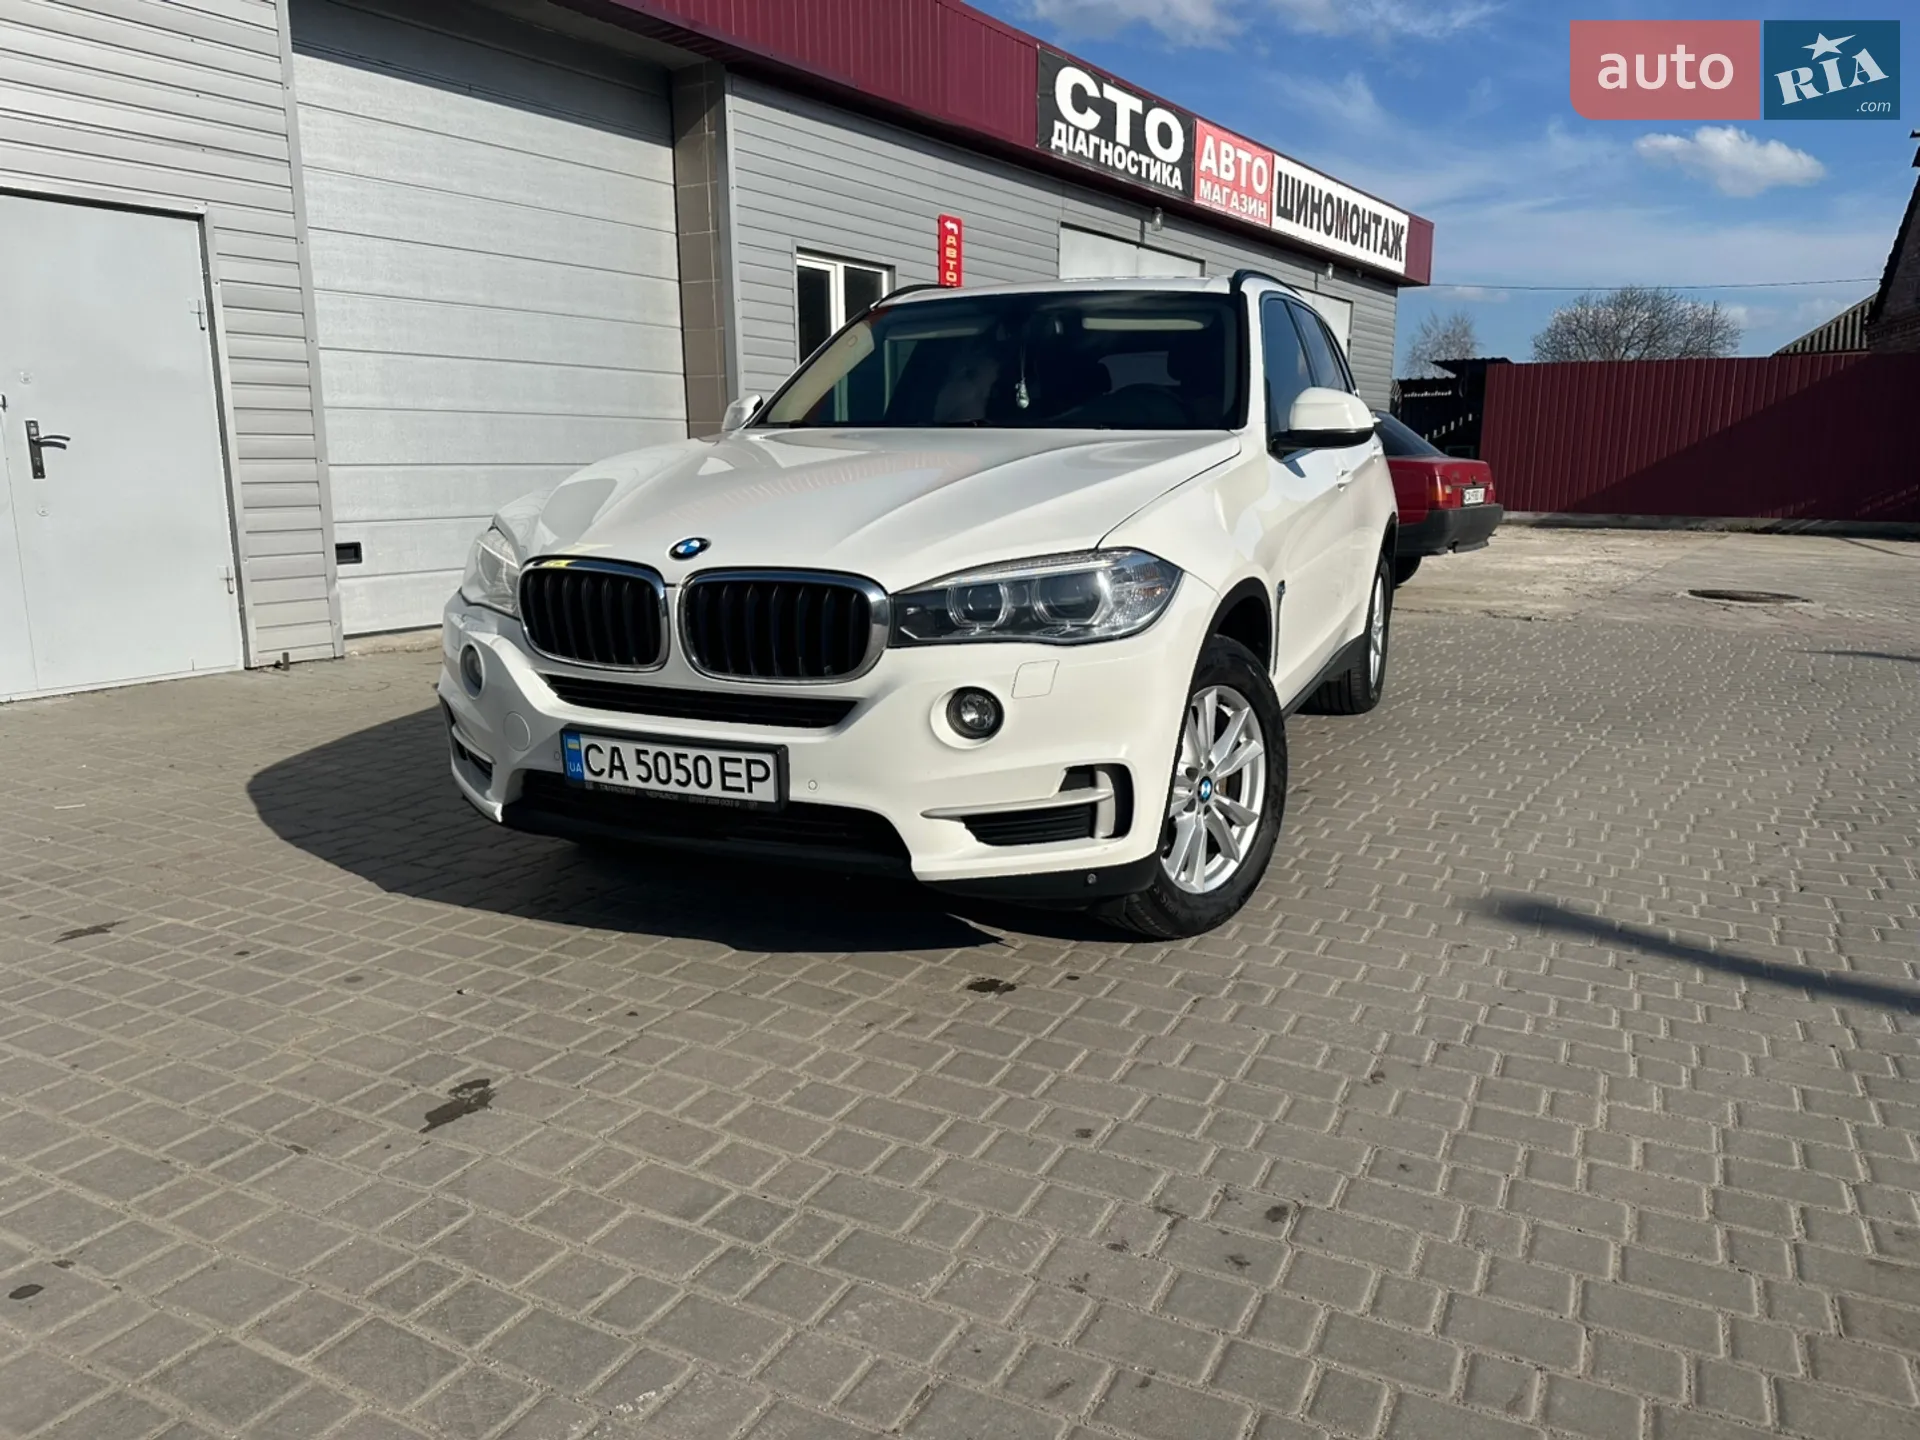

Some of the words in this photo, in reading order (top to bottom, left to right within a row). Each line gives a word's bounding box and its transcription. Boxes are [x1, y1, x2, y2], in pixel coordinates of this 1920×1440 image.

[1054, 66, 1184, 163] СТО
[1051, 119, 1183, 191] ДІАГНОСТИКА
[1199, 135, 1268, 195] АВТО
[1199, 182, 1268, 220] МАГАЗИН
[1276, 170, 1407, 263] ШИНОМОНТАЖ
[569, 761, 583, 773] UA
[584, 743, 629, 781] CA
[634, 748, 713, 789] 5050
[719, 756, 771, 794] EP
